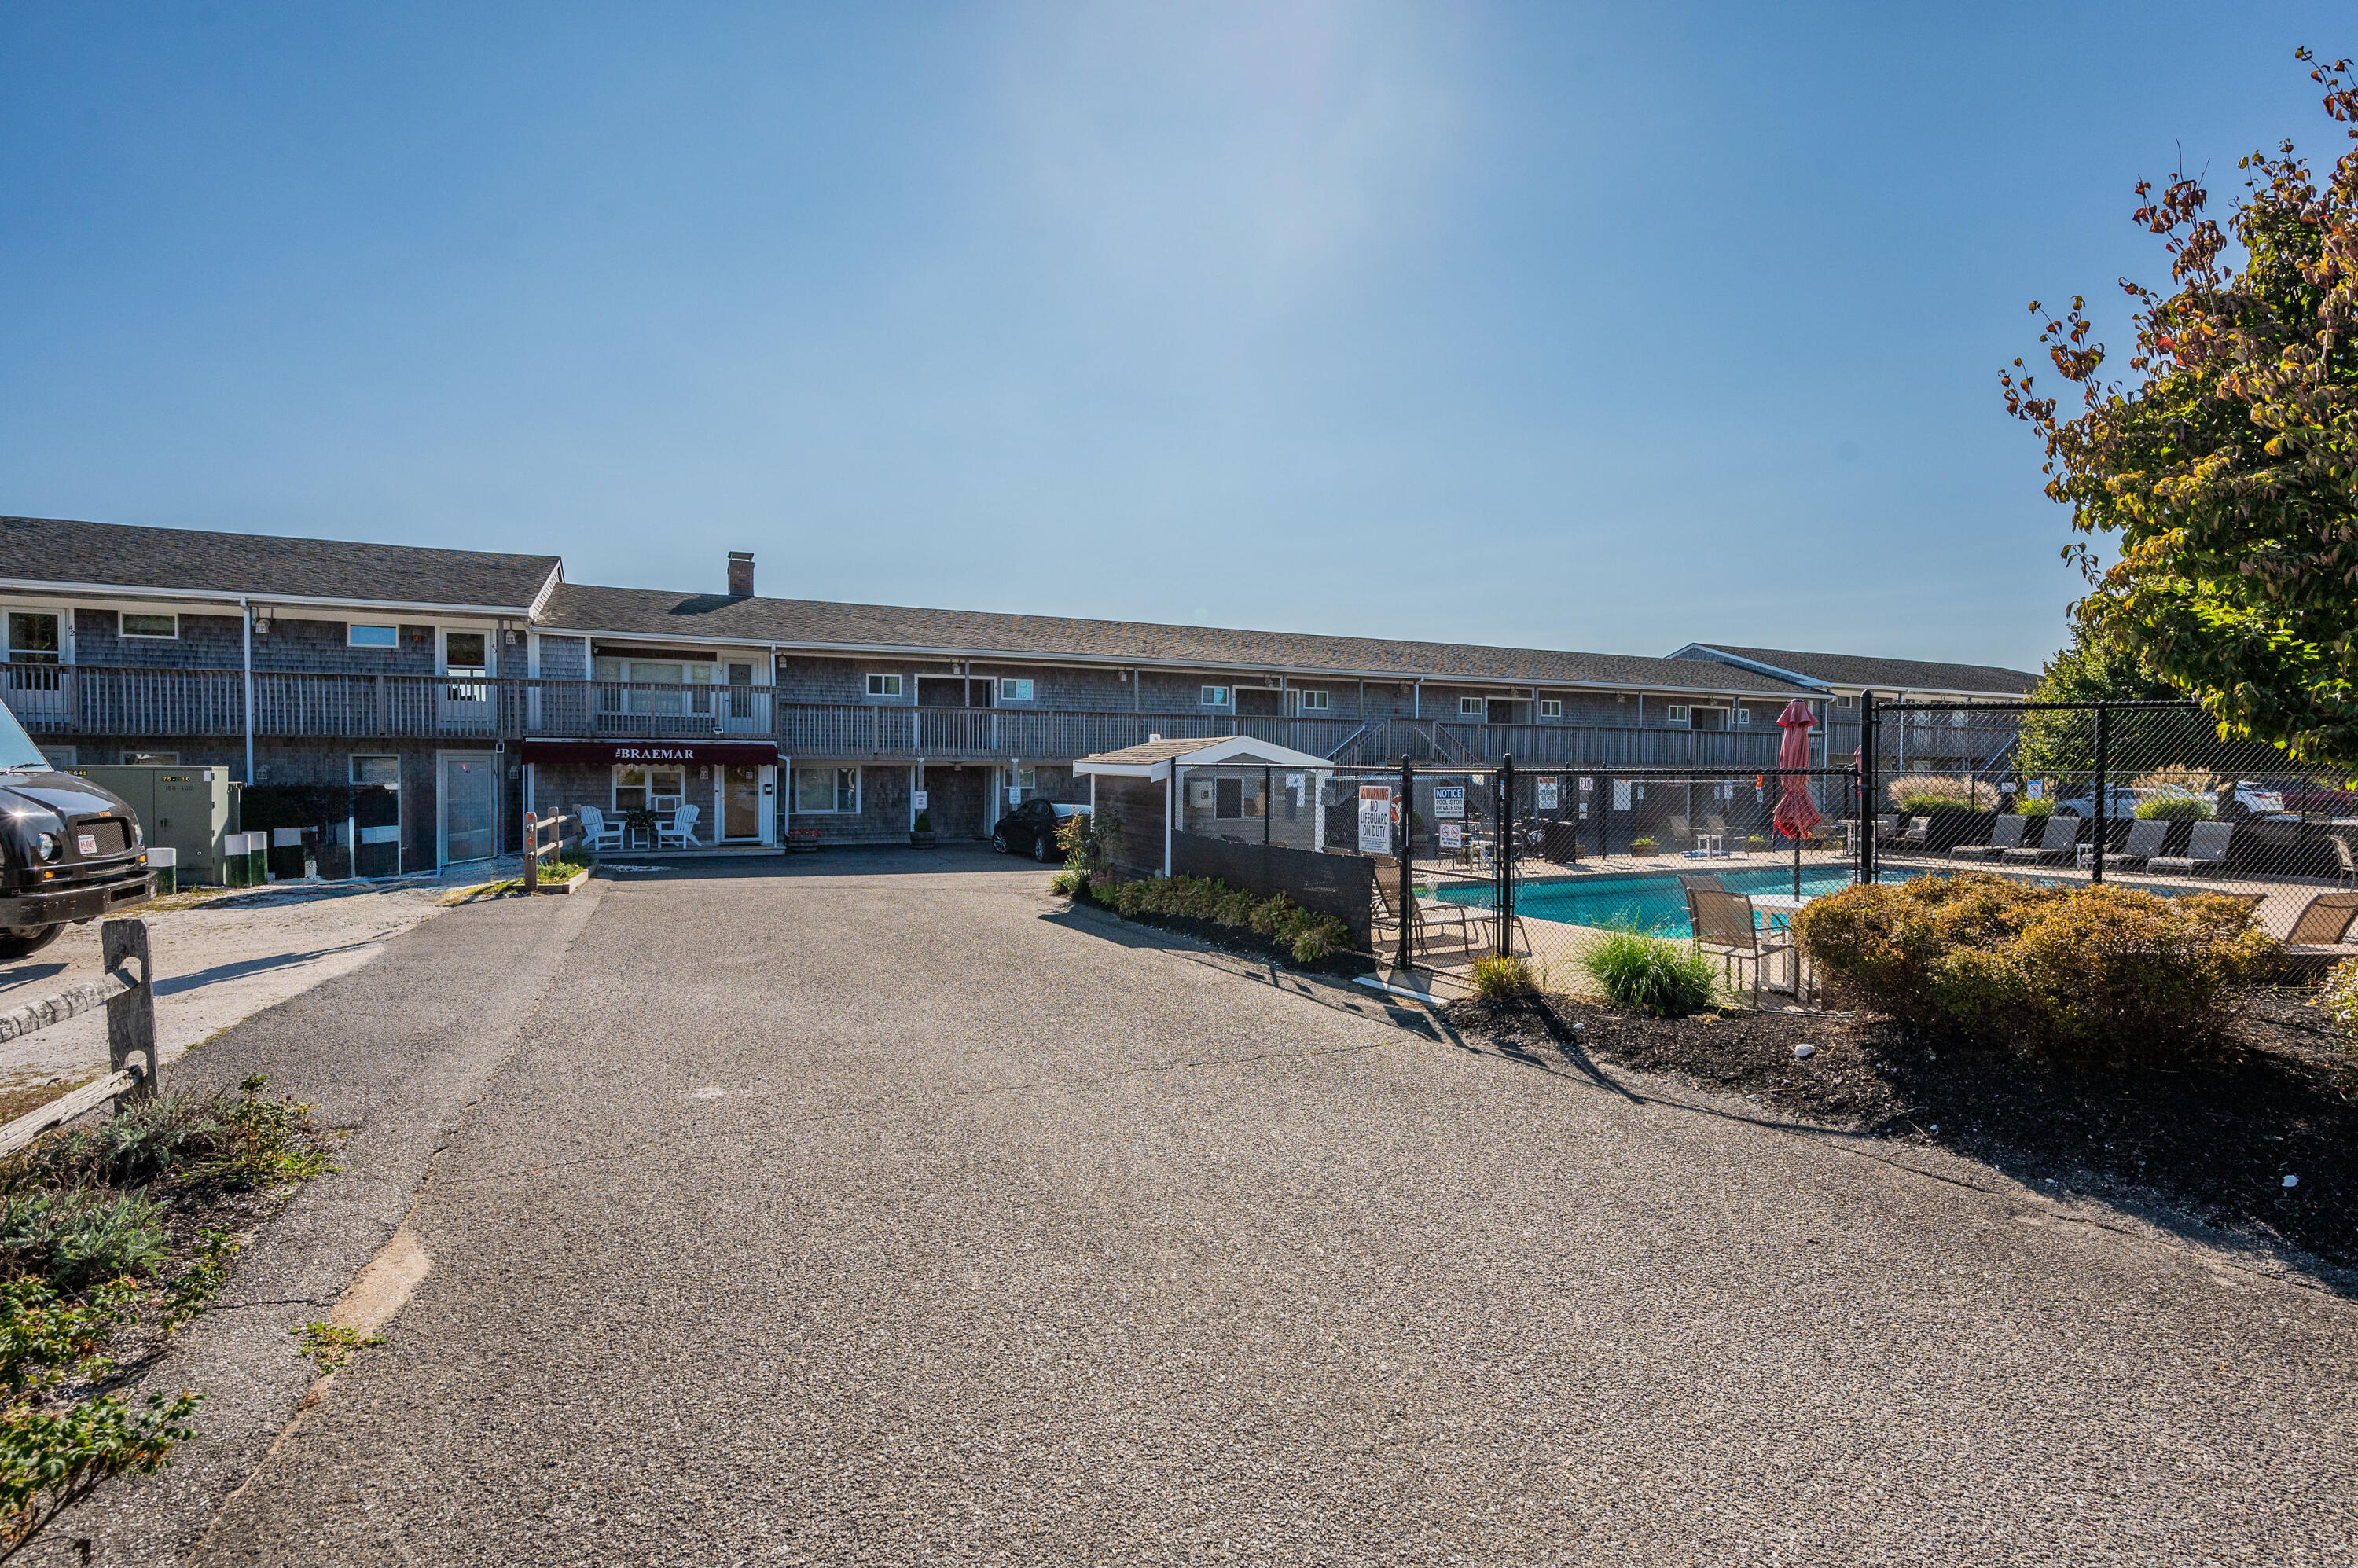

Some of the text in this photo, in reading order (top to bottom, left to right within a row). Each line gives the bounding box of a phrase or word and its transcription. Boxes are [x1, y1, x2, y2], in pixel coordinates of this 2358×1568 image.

[621, 748, 695, 758] BRAEMAR
[1580, 779, 1592, 789] EXIT
[1366, 788, 1389, 800] WARNING
[1436, 789, 1462, 798] NOTICE
[1370, 800, 1378, 812] NO
[1361, 812, 1388, 825] LIFEGUARD
[1363, 824, 1386, 838] ON DUTY
